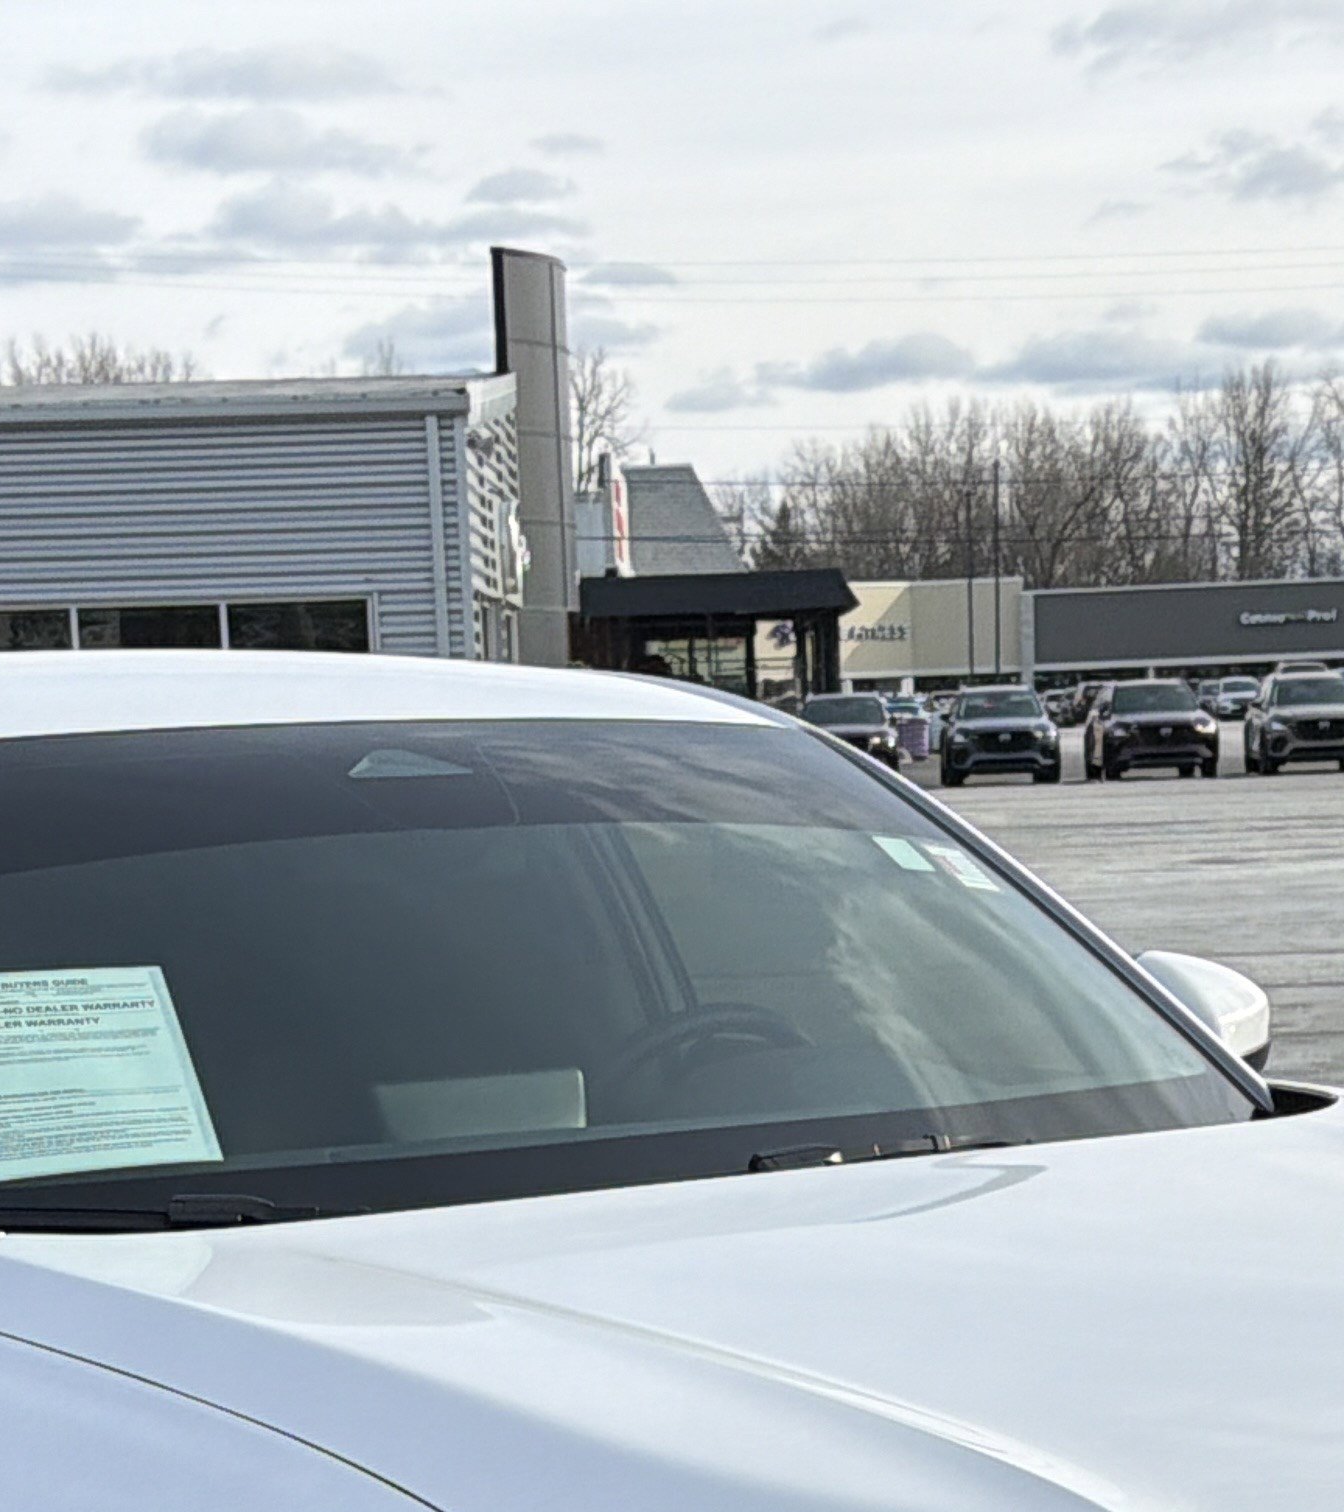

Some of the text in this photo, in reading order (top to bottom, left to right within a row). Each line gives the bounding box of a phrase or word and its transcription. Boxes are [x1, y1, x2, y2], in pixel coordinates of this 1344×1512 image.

[25, 1004, 79, 1014] DEALER
[81, 1000, 155, 1012] WARRANTY
[24, 1016, 101, 1028] WARRANTY
